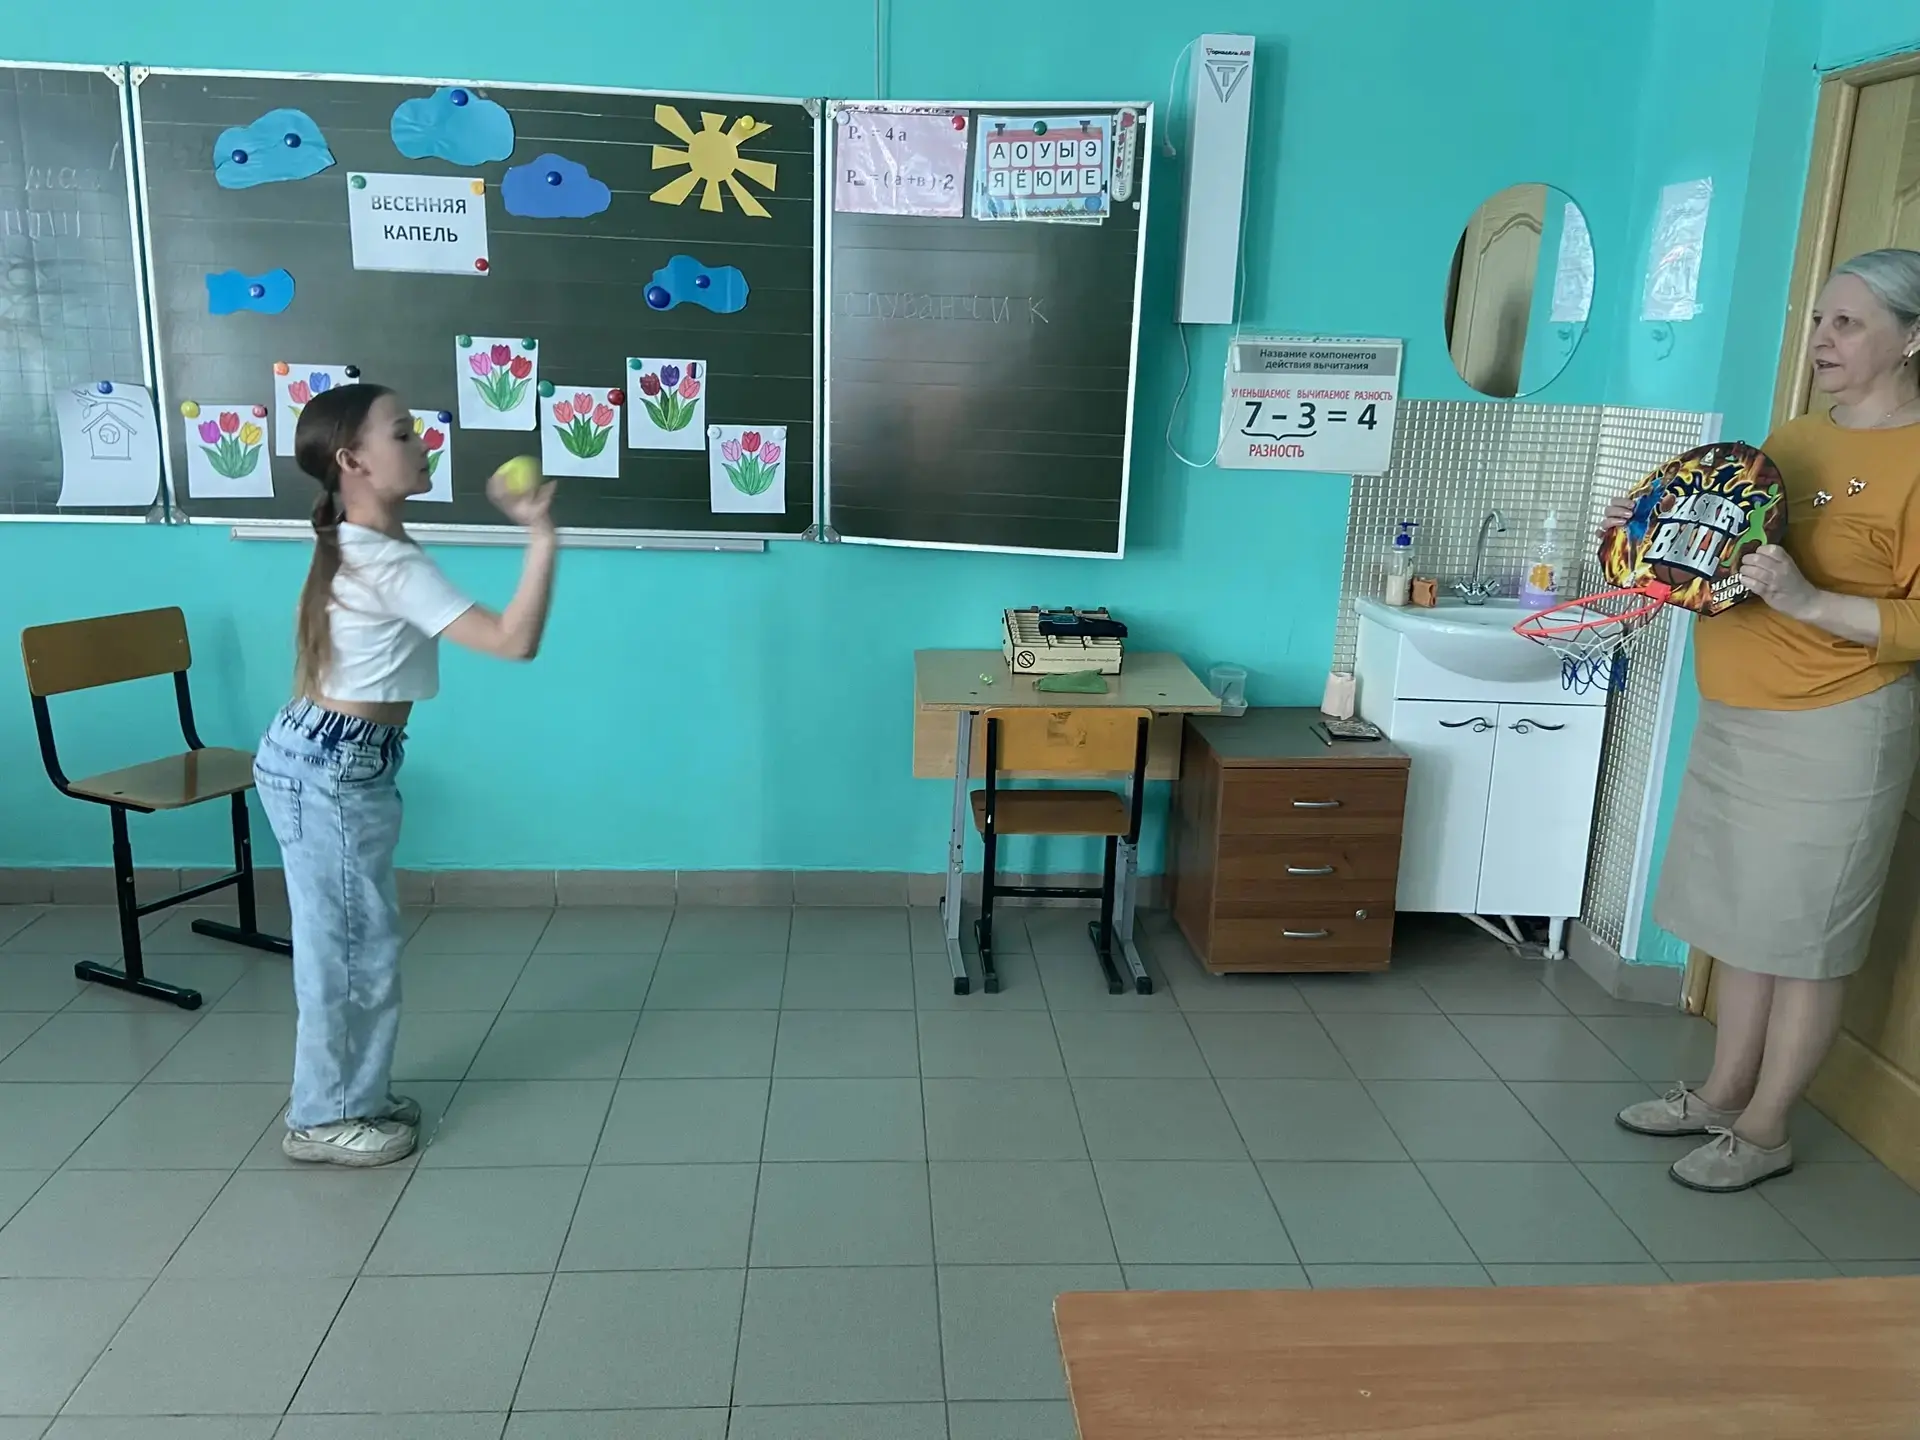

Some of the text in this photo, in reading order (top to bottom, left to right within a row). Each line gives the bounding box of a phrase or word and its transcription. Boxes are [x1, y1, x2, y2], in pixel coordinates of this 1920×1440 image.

[992, 141, 1097, 160] А О У Ы Э
[993, 170, 1096, 188] Я Ё Ю И Е
[371, 195, 467, 214] ВЕСЕННЯЯ
[384, 225, 458, 242] КАПЕЛЬ
[1259, 349, 1377, 360] Название компонентов
[1265, 360, 1369, 370] действия вычитания
[1231, 388, 1393, 401] УМЕНЬШАЕМОЕ ВЫЧИТАЕМОЕ РАЗНОСТЬ
[1245, 401, 1262, 428] 7
[1298, 402, 1316, 429] 3
[1357, 403, 1377, 430] 4
[1249, 444, 1305, 458] РАЗНОСТЬ
[1657, 493, 1745, 536] BASKET
[1643, 522, 1720, 577] BALL
[1712, 584, 1749, 605] SHOO
